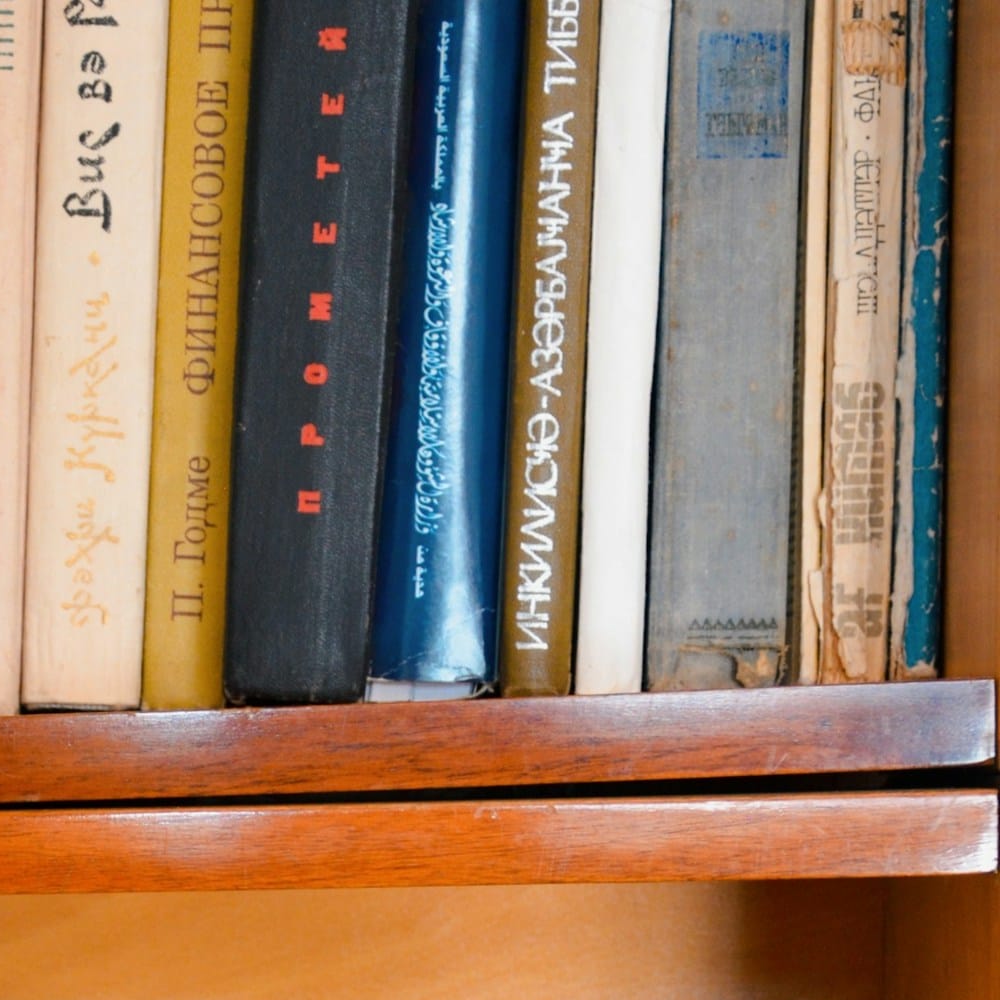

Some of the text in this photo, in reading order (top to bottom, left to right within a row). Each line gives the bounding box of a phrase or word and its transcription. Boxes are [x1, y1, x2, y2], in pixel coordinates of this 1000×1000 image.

[62, 0, 119, 27] Р
[77, 51, 112, 104] вә
[181, 80, 230, 396] ФИНАНСОВОЕ
[296, 26, 348, 514] ПРОМЕТЕЙ
[173, 455, 217, 565] Годме
[171, 583, 205, 622] П.
